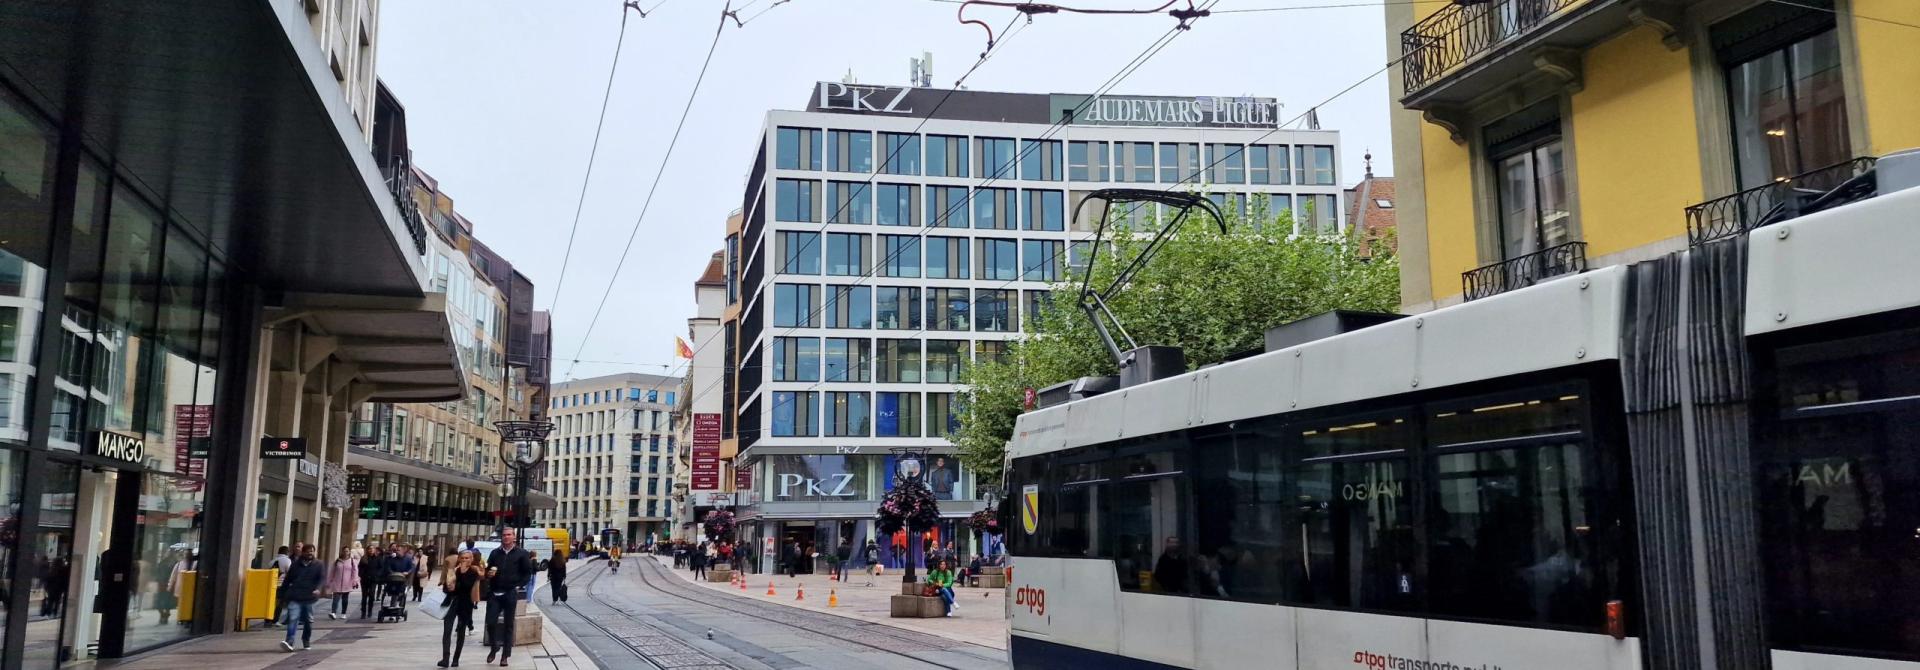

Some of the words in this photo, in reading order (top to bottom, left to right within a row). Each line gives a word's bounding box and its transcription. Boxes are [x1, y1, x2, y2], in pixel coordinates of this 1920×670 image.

[816, 82, 912, 113] PKZ
[1084, 96, 1204, 123] AUDEMARS
[1211, 96, 1284, 125] PIGUET
[98, 431, 143, 463] MANGO
[777, 474, 855, 497] PKZ
